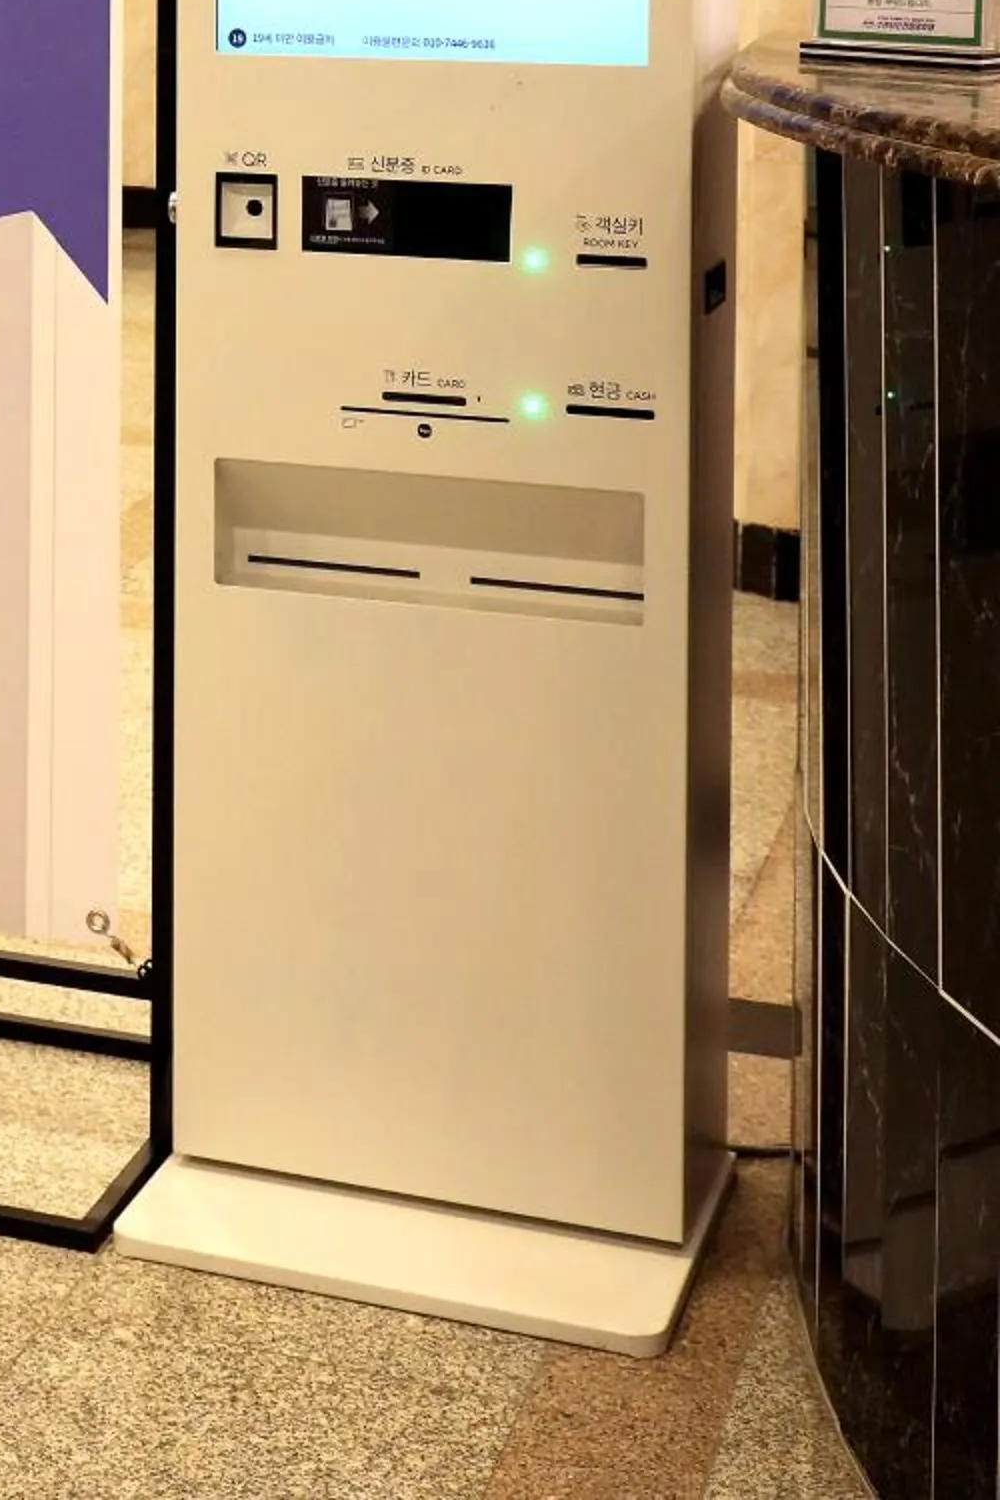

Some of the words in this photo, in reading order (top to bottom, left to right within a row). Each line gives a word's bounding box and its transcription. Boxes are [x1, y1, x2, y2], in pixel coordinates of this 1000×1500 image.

[241, 151, 267, 167] QR
[371, 156, 415, 174] 신분증
[433, 166, 462, 175] CARD
[595, 216, 643, 237] 객실키
[583, 237, 615, 248] ROOM
[617, 239, 639, 249] KEY
[401, 370, 431, 387] 카드
[437, 380, 466, 389] CARD
[589, 381, 621, 400] 현금
[625, 391, 656, 401] CASH
